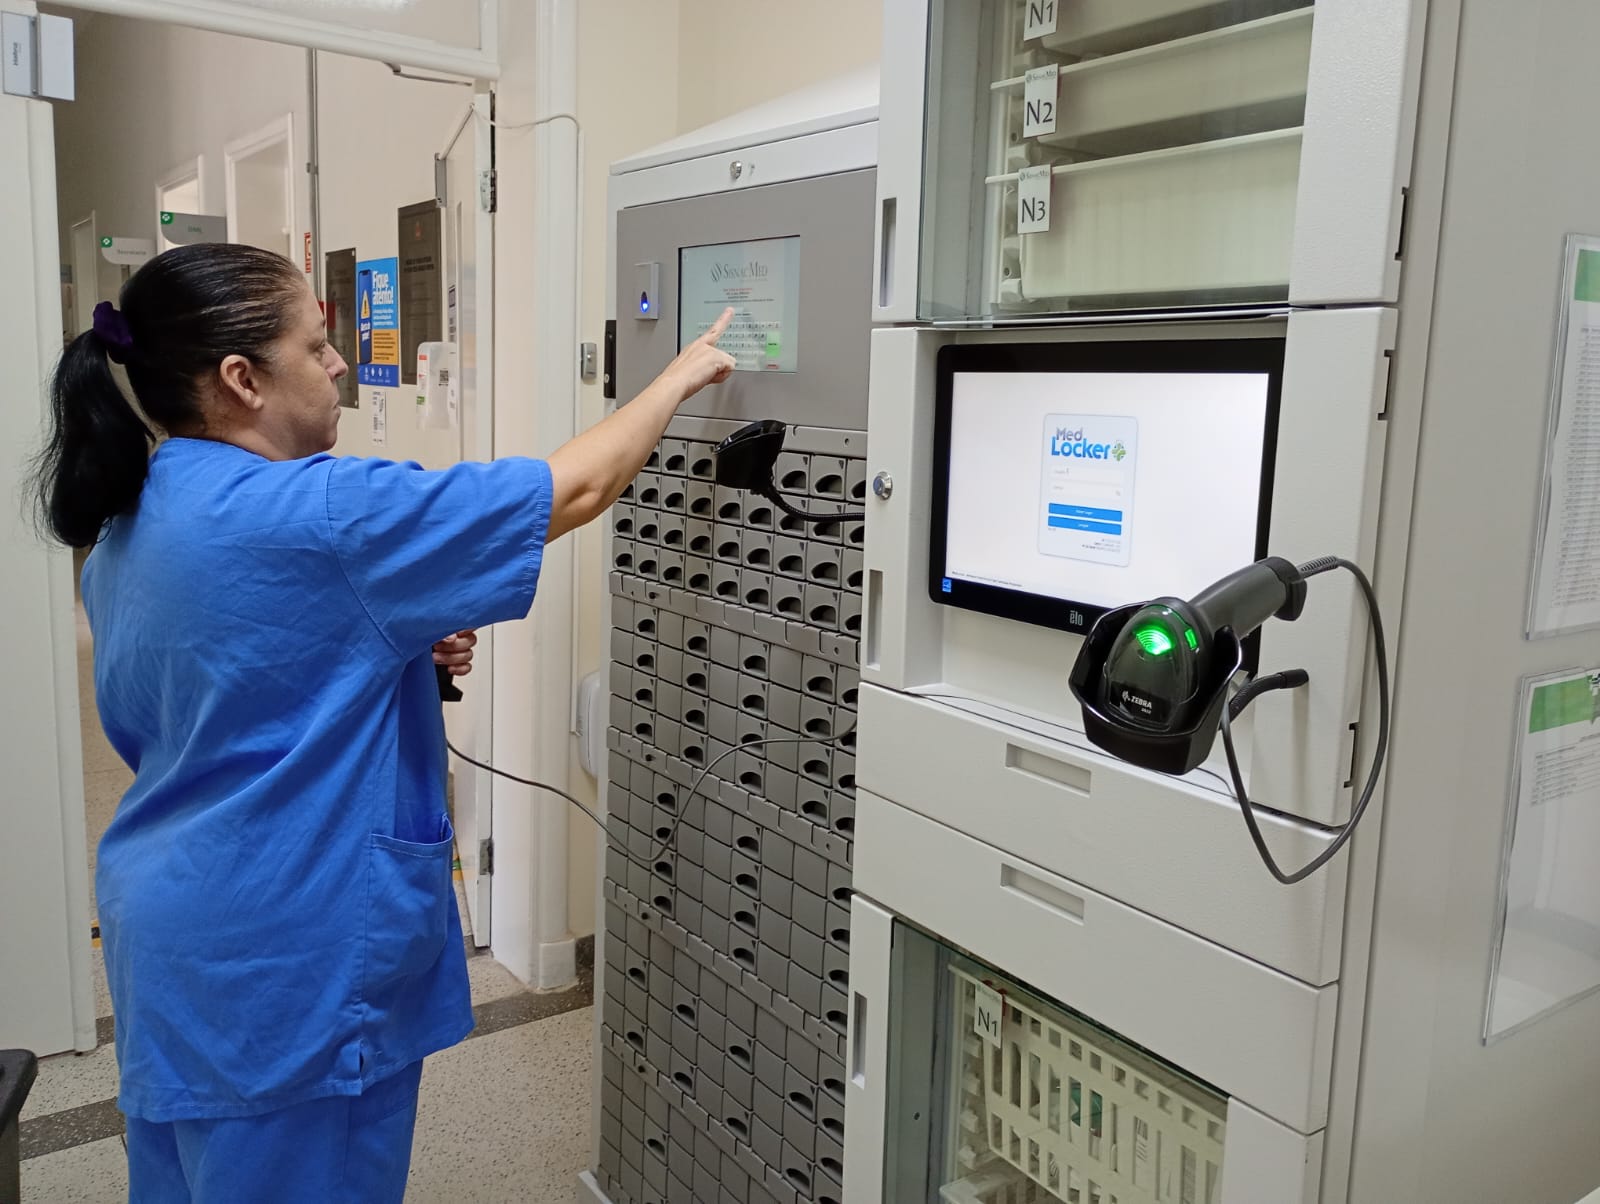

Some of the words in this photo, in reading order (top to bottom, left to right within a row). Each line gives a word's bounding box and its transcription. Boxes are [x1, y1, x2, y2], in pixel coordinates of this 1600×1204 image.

[1029, 0, 1054, 28] N1
[1026, 99, 1053, 126] N2
[1021, 197, 1046, 223] N3
[372, 270, 389, 290] Fique
[372, 285, 394, 305] atento!
[1056, 426, 1083, 441] Med
[1051, 435, 1111, 460] Locker
[1131, 695, 1152, 709] ZEBRA
[978, 1006, 998, 1038] N1
